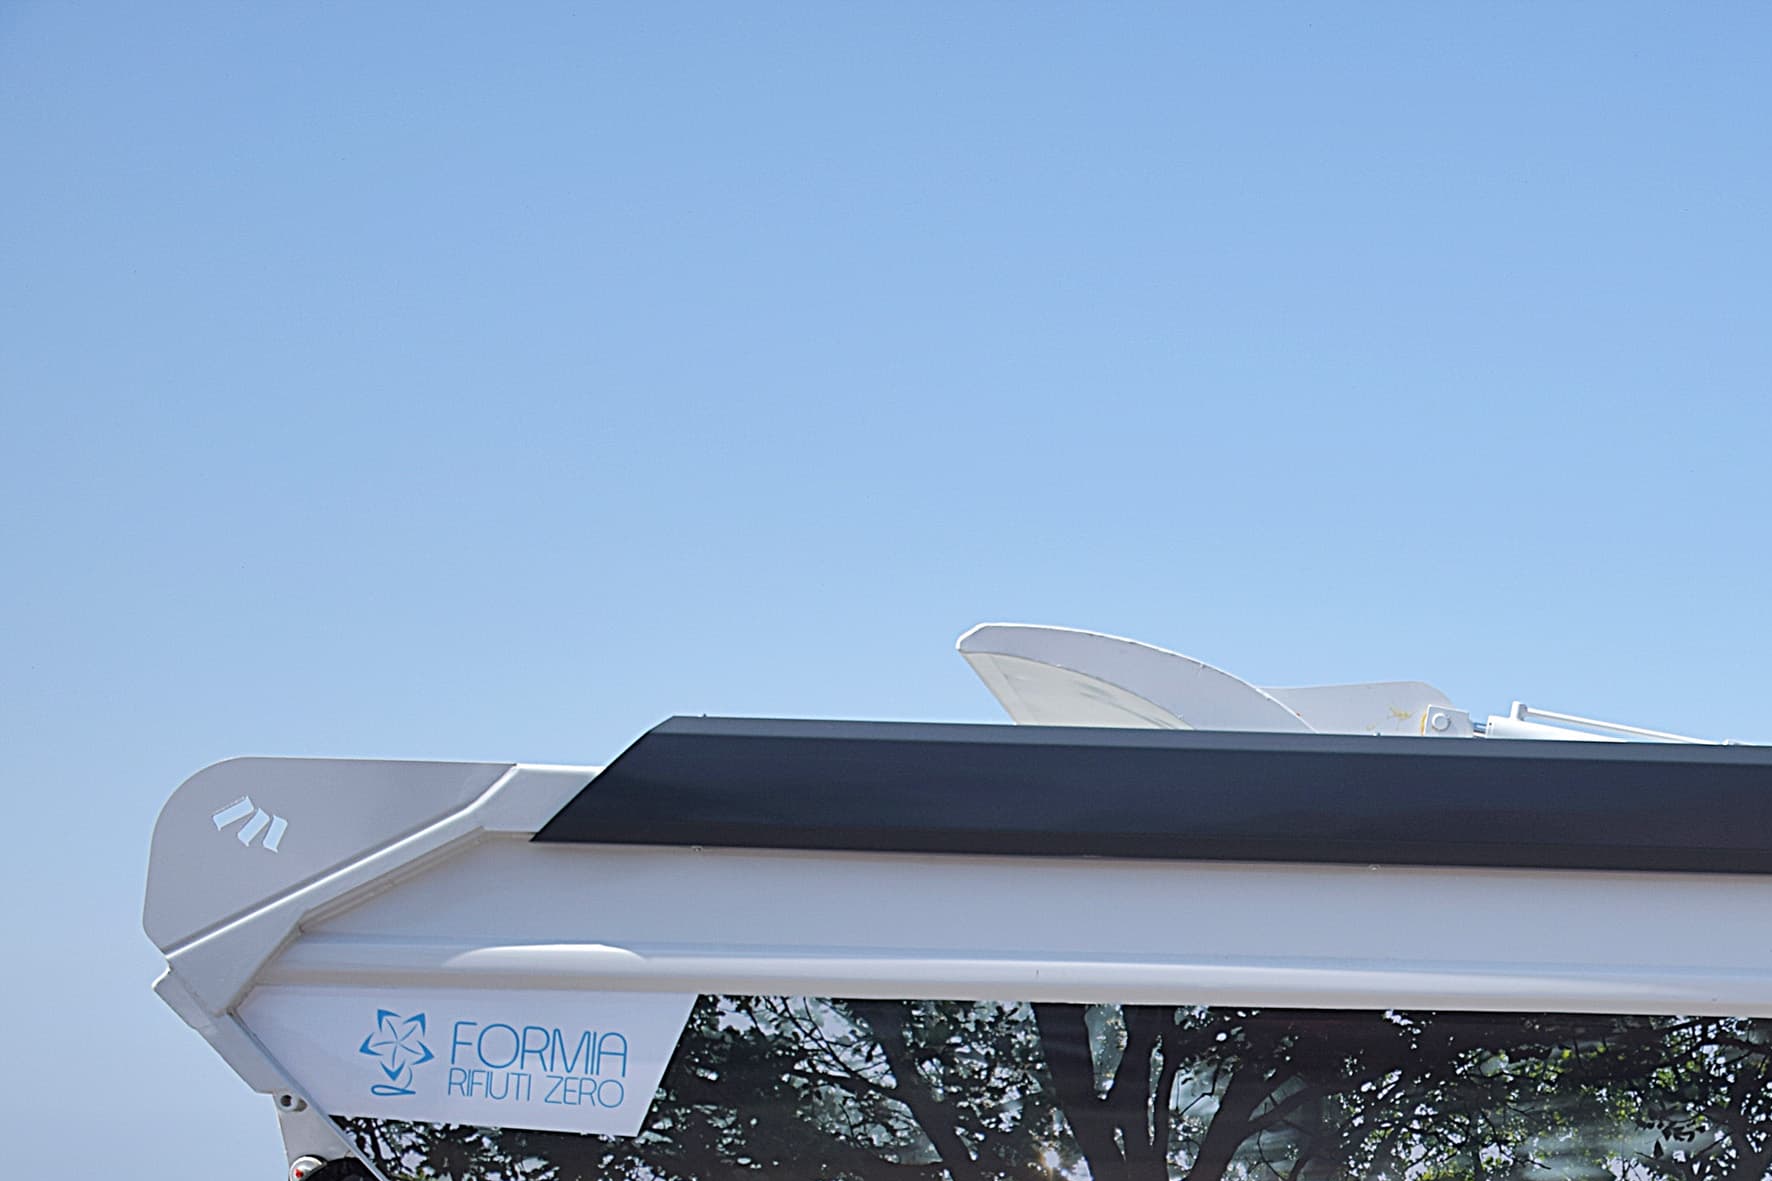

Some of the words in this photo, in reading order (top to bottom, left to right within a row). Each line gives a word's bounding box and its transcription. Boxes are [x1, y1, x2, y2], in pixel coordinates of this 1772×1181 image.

[450, 1020, 629, 1078] FORMIA
[447, 1066, 533, 1102] RIFIUTI
[543, 1074, 626, 1109] ZERO
